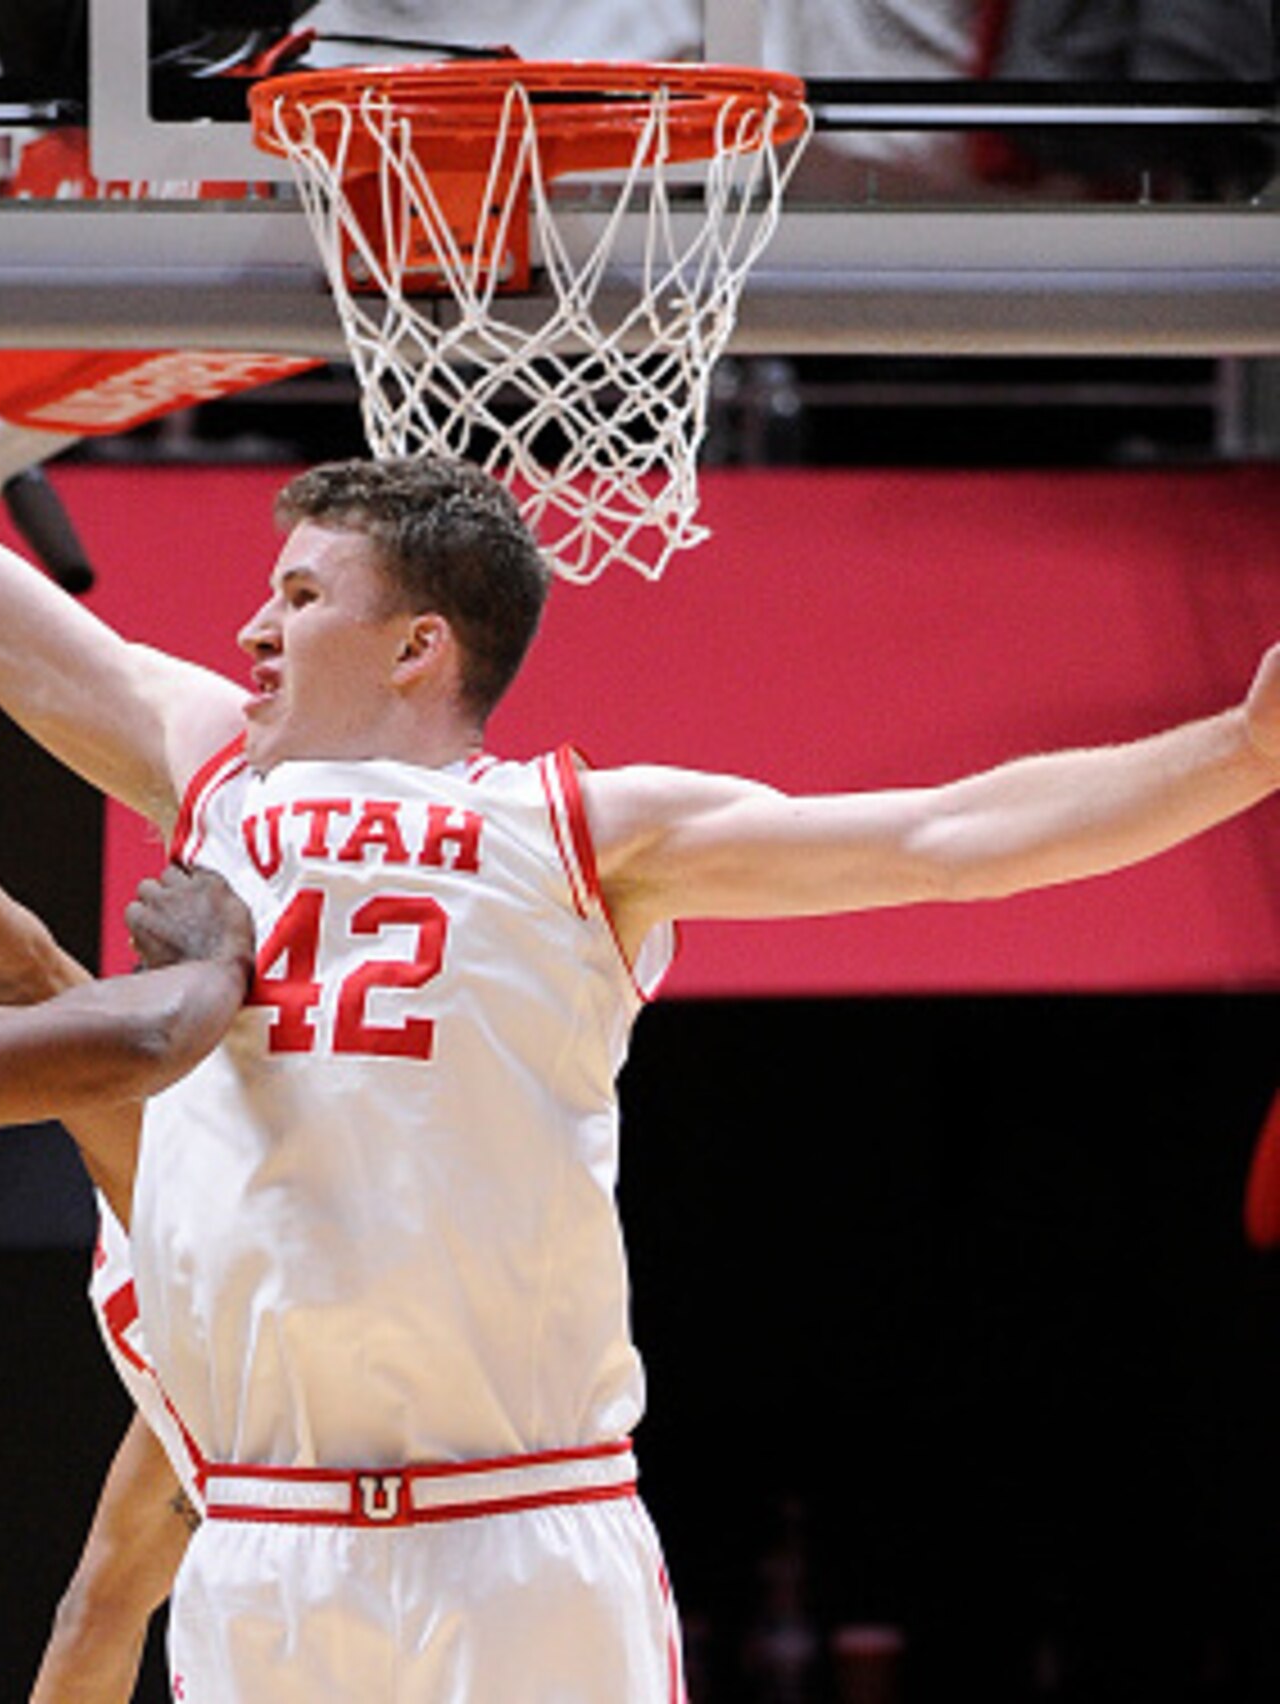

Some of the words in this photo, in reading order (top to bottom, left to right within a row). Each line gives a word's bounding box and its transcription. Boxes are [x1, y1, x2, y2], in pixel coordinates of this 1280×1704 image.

[241, 798, 484, 880] UTAH
[243, 887, 450, 1061] 42
[359, 1475, 403, 1520] U
